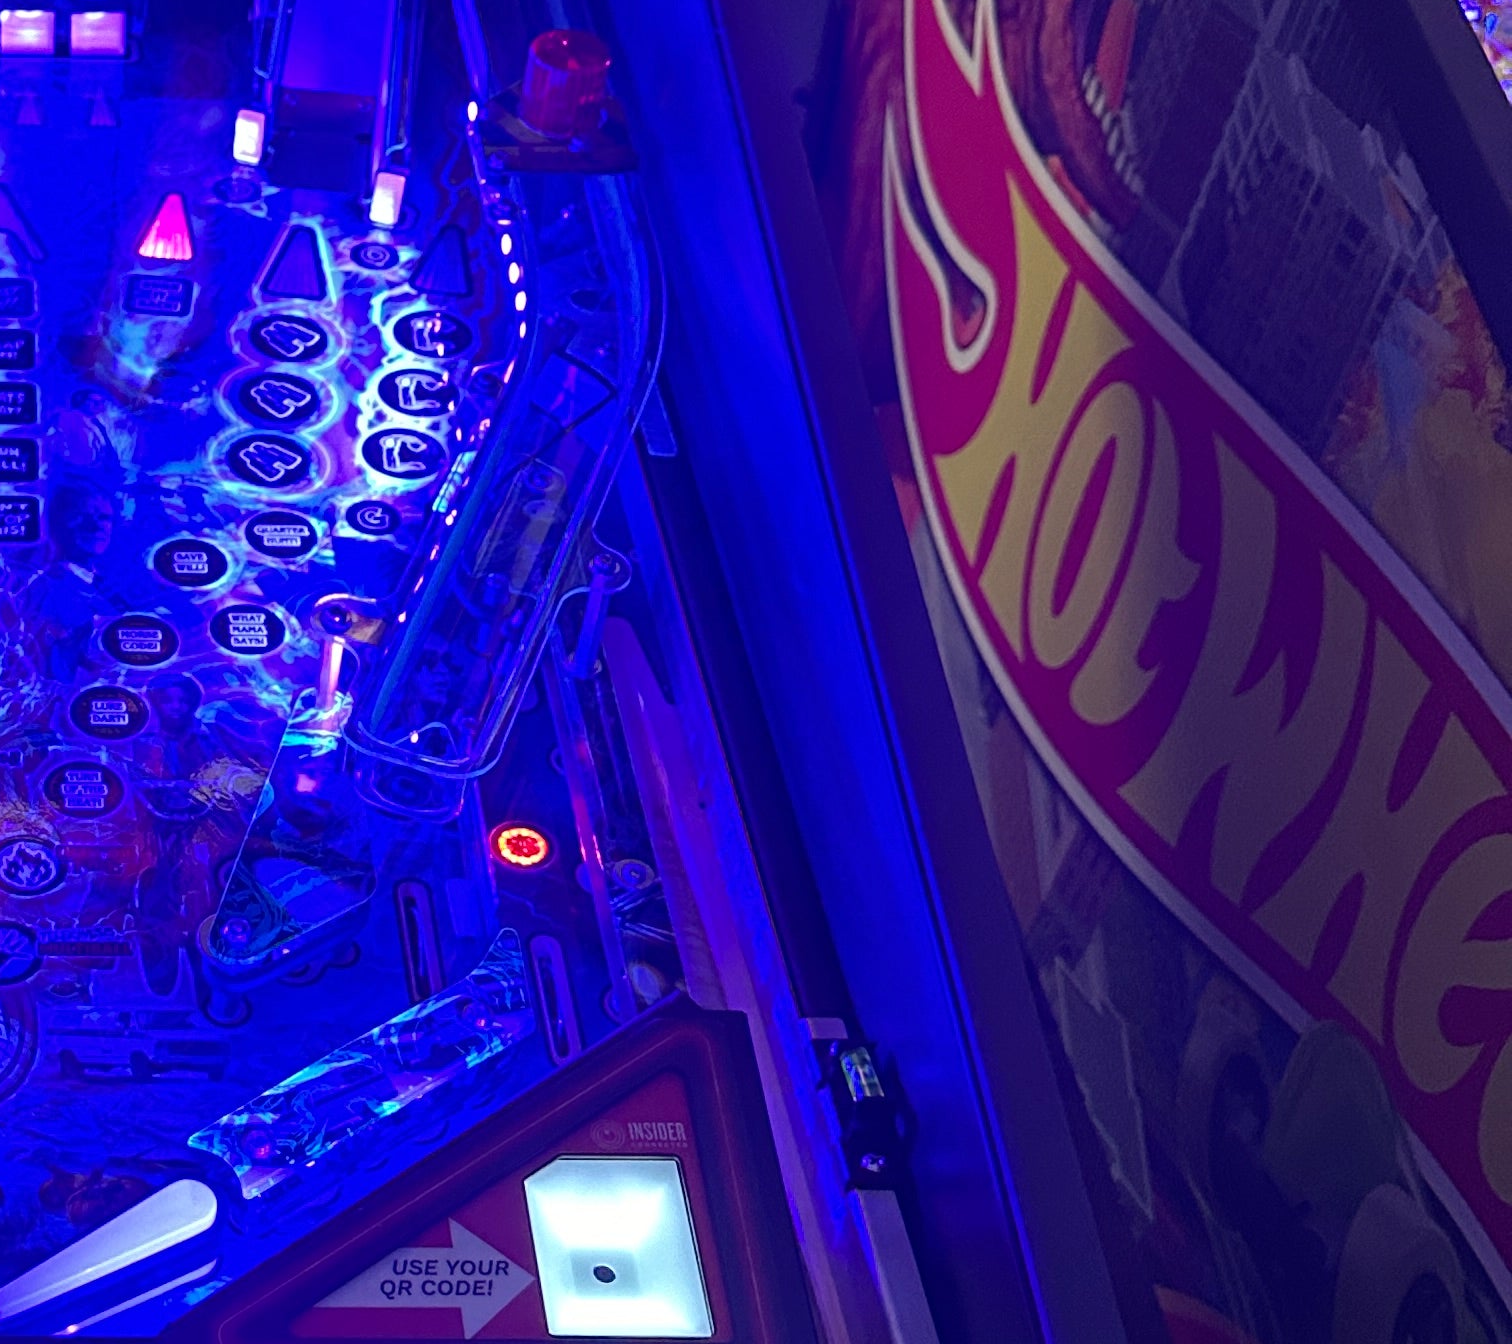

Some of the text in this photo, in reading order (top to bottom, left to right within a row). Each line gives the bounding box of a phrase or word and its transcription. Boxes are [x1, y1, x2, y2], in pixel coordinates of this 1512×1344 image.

[628, 1122, 688, 1142] INSIDER
[392, 1259, 511, 1277] USE YOUR
[380, 1279, 493, 1300] QR CODE!
